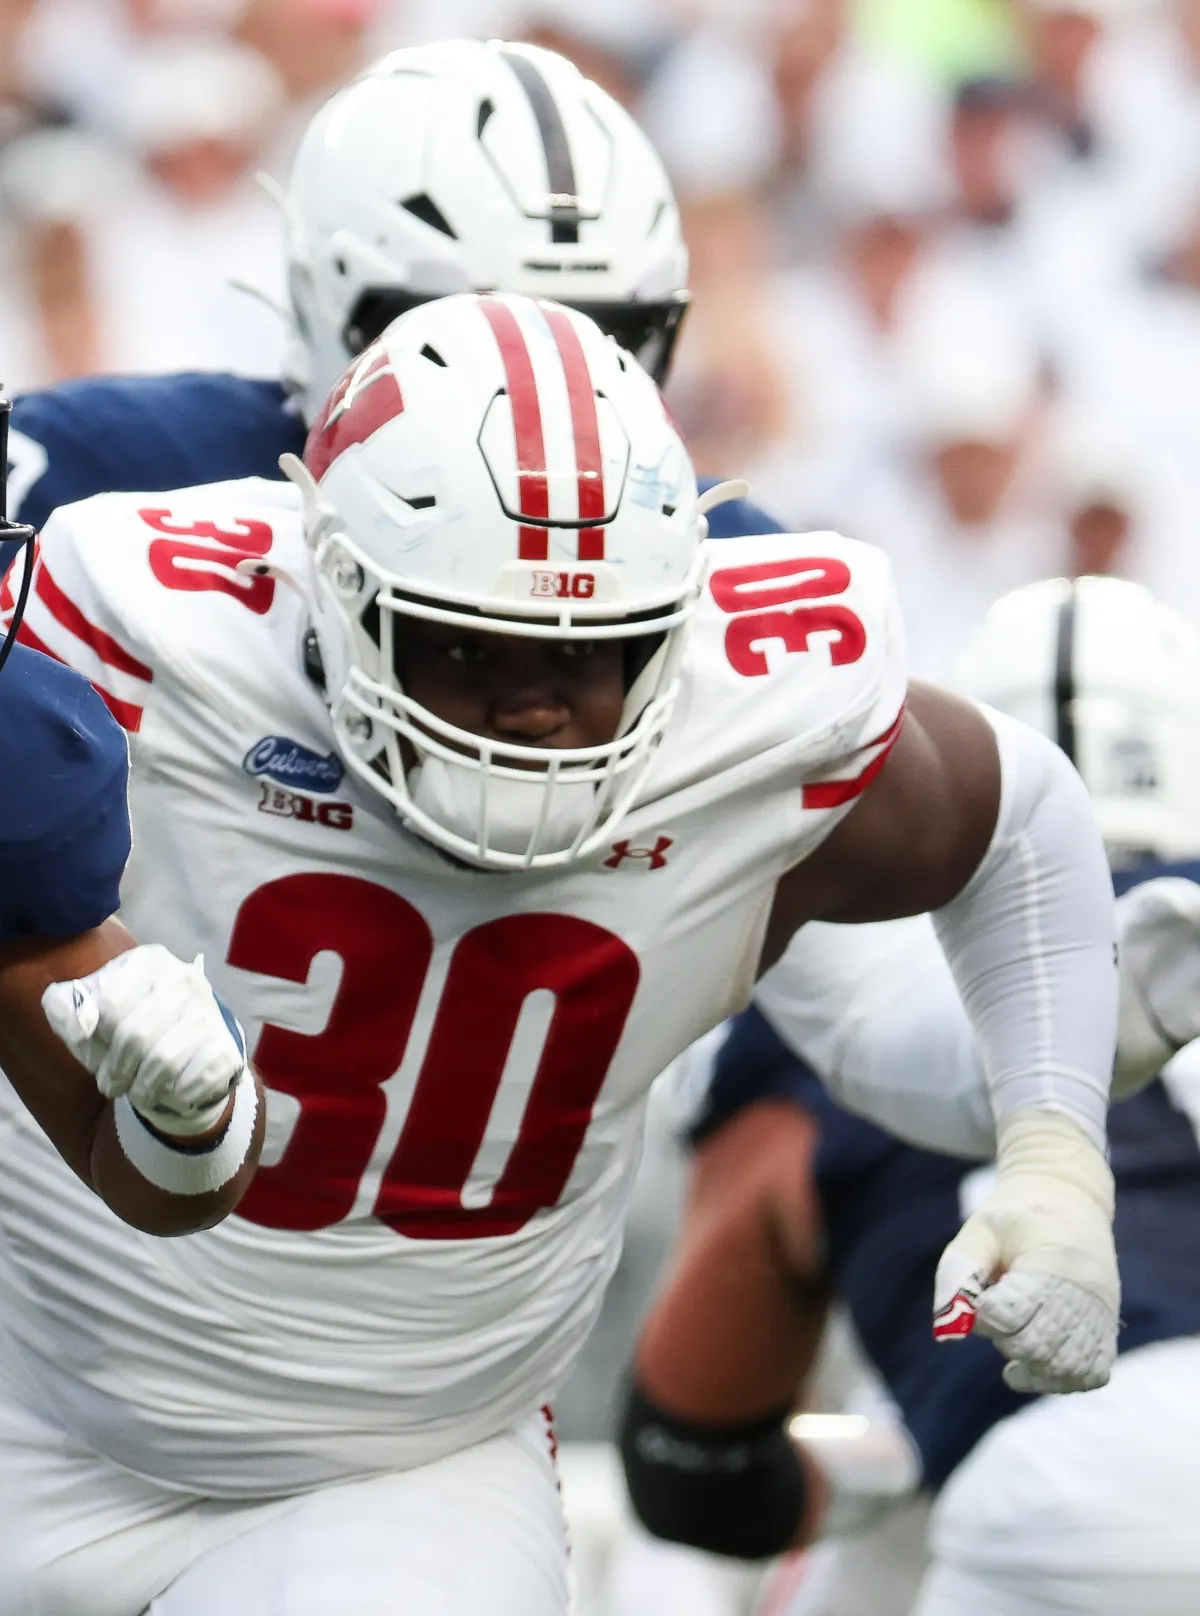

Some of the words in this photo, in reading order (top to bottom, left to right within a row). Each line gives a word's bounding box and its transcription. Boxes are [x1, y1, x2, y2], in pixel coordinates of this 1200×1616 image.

[137, 508, 275, 615] 30
[709, 557, 866, 677] 30
[226, 872, 641, 1240] 30
